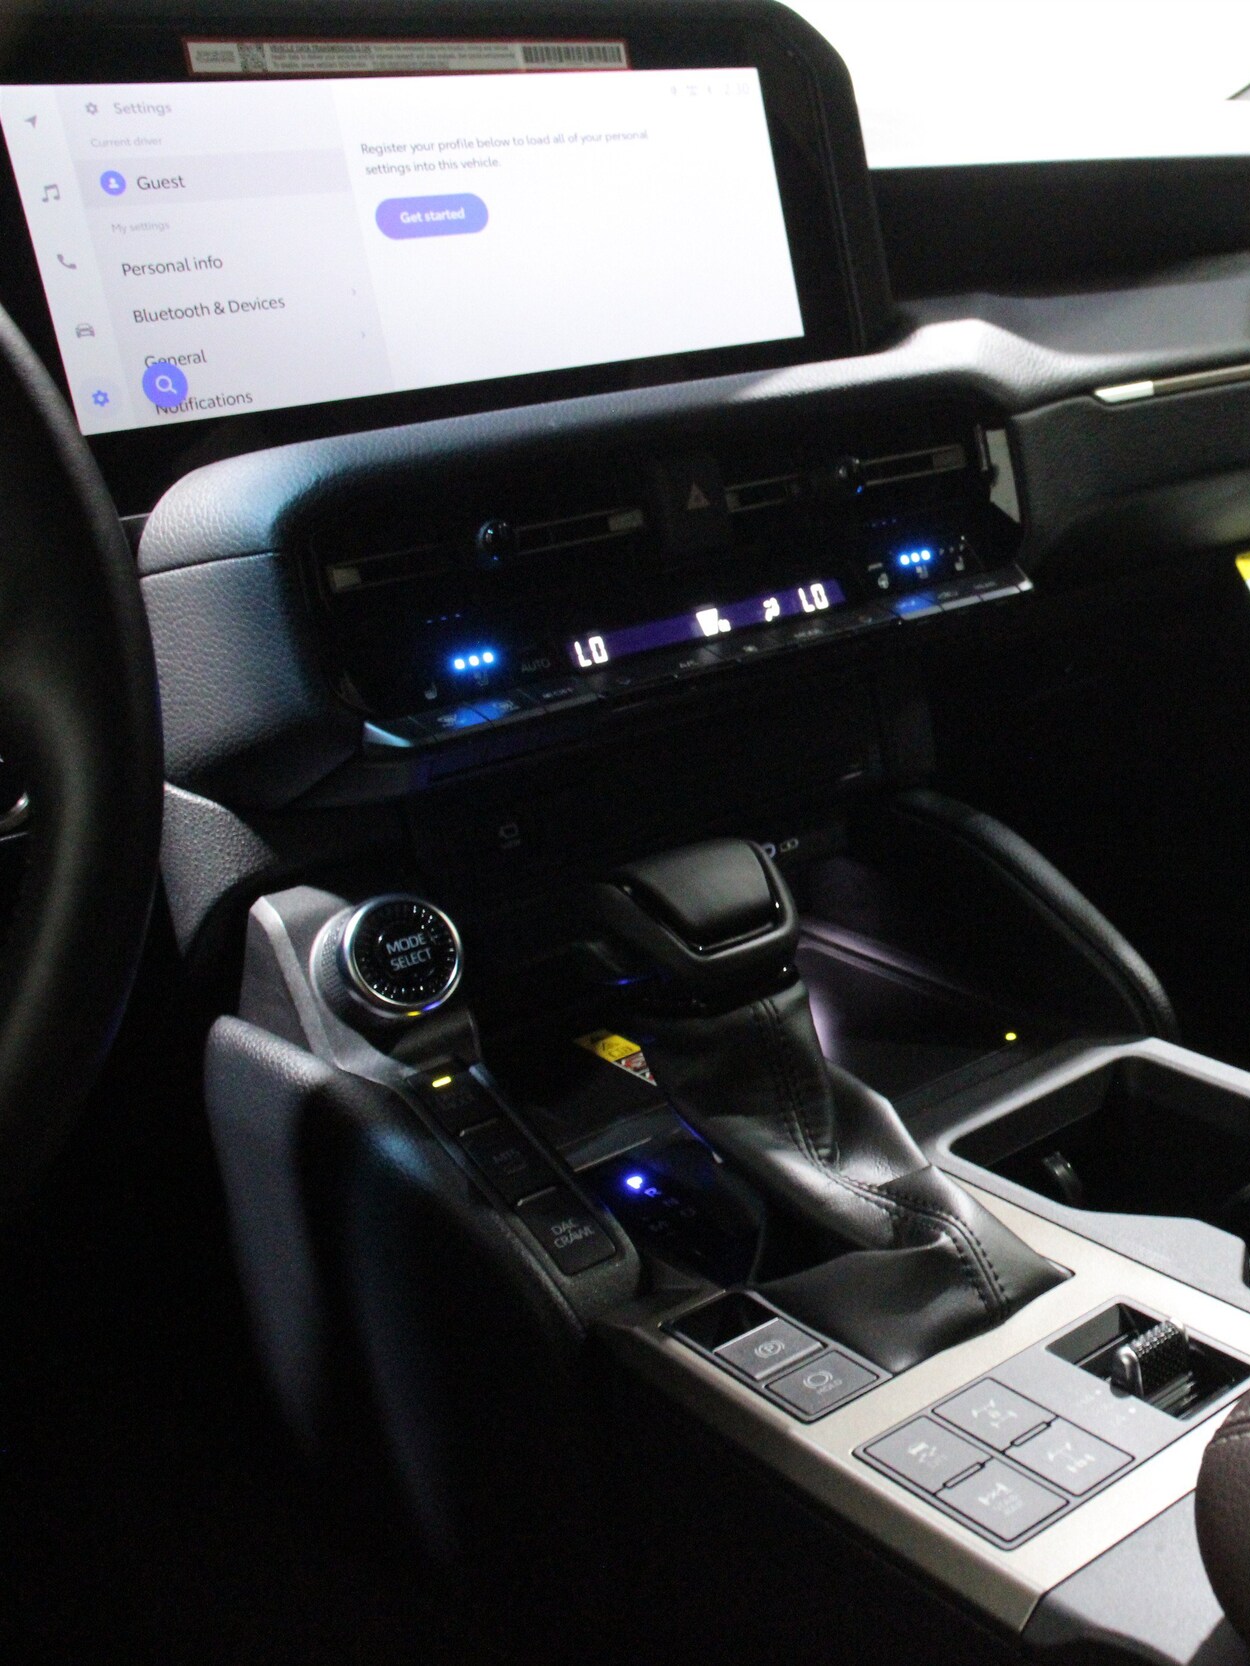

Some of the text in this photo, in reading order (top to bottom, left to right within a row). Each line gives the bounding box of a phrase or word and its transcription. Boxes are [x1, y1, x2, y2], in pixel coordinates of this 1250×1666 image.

[114, 101, 171, 117] Settings
[90, 135, 162, 148] Current driver
[361, 129, 648, 157] Register your profile below to load all of your personal
[366, 156, 501, 176] settings into this vehicle.
[137, 174, 186, 191] Guest
[400, 206, 465, 225] Get started
[111, 219, 170, 235] My settings
[121, 255, 224, 277] Personal info
[133, 294, 286, 325] Bluetooth & Devices
[797, 583, 829, 613] LO
[574, 636, 609, 668] LO
[386, 932, 427, 955] MODE
[390, 947, 432, 972] SELECT
[551, 1218, 577, 1235] DAC
[554, 1226, 596, 1249] CRAWL
